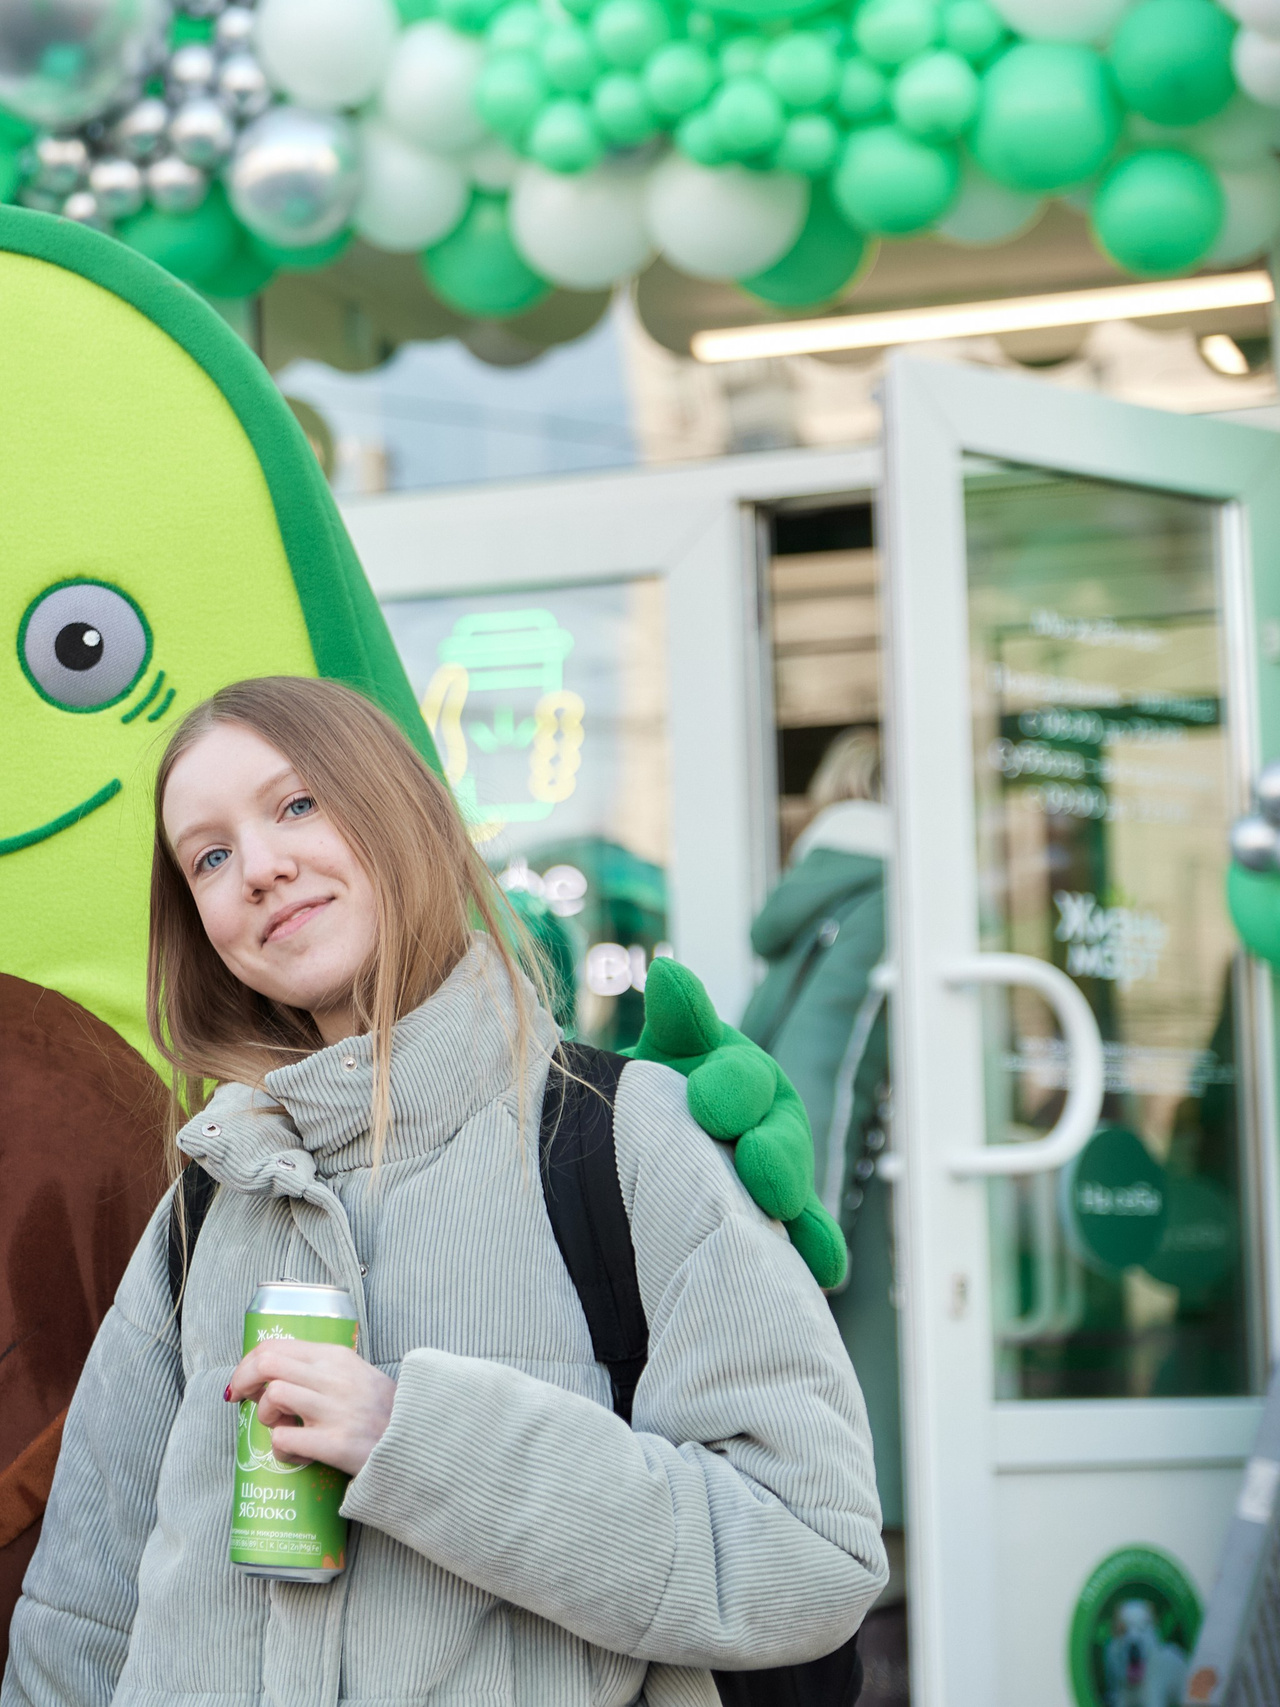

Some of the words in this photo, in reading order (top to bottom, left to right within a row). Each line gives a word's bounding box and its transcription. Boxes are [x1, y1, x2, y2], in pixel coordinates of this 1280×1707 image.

[241, 1482, 296, 1503] Шорли
[239, 1502, 297, 1521] Яблоко
[256, 1530, 317, 1540] микроэлементы
